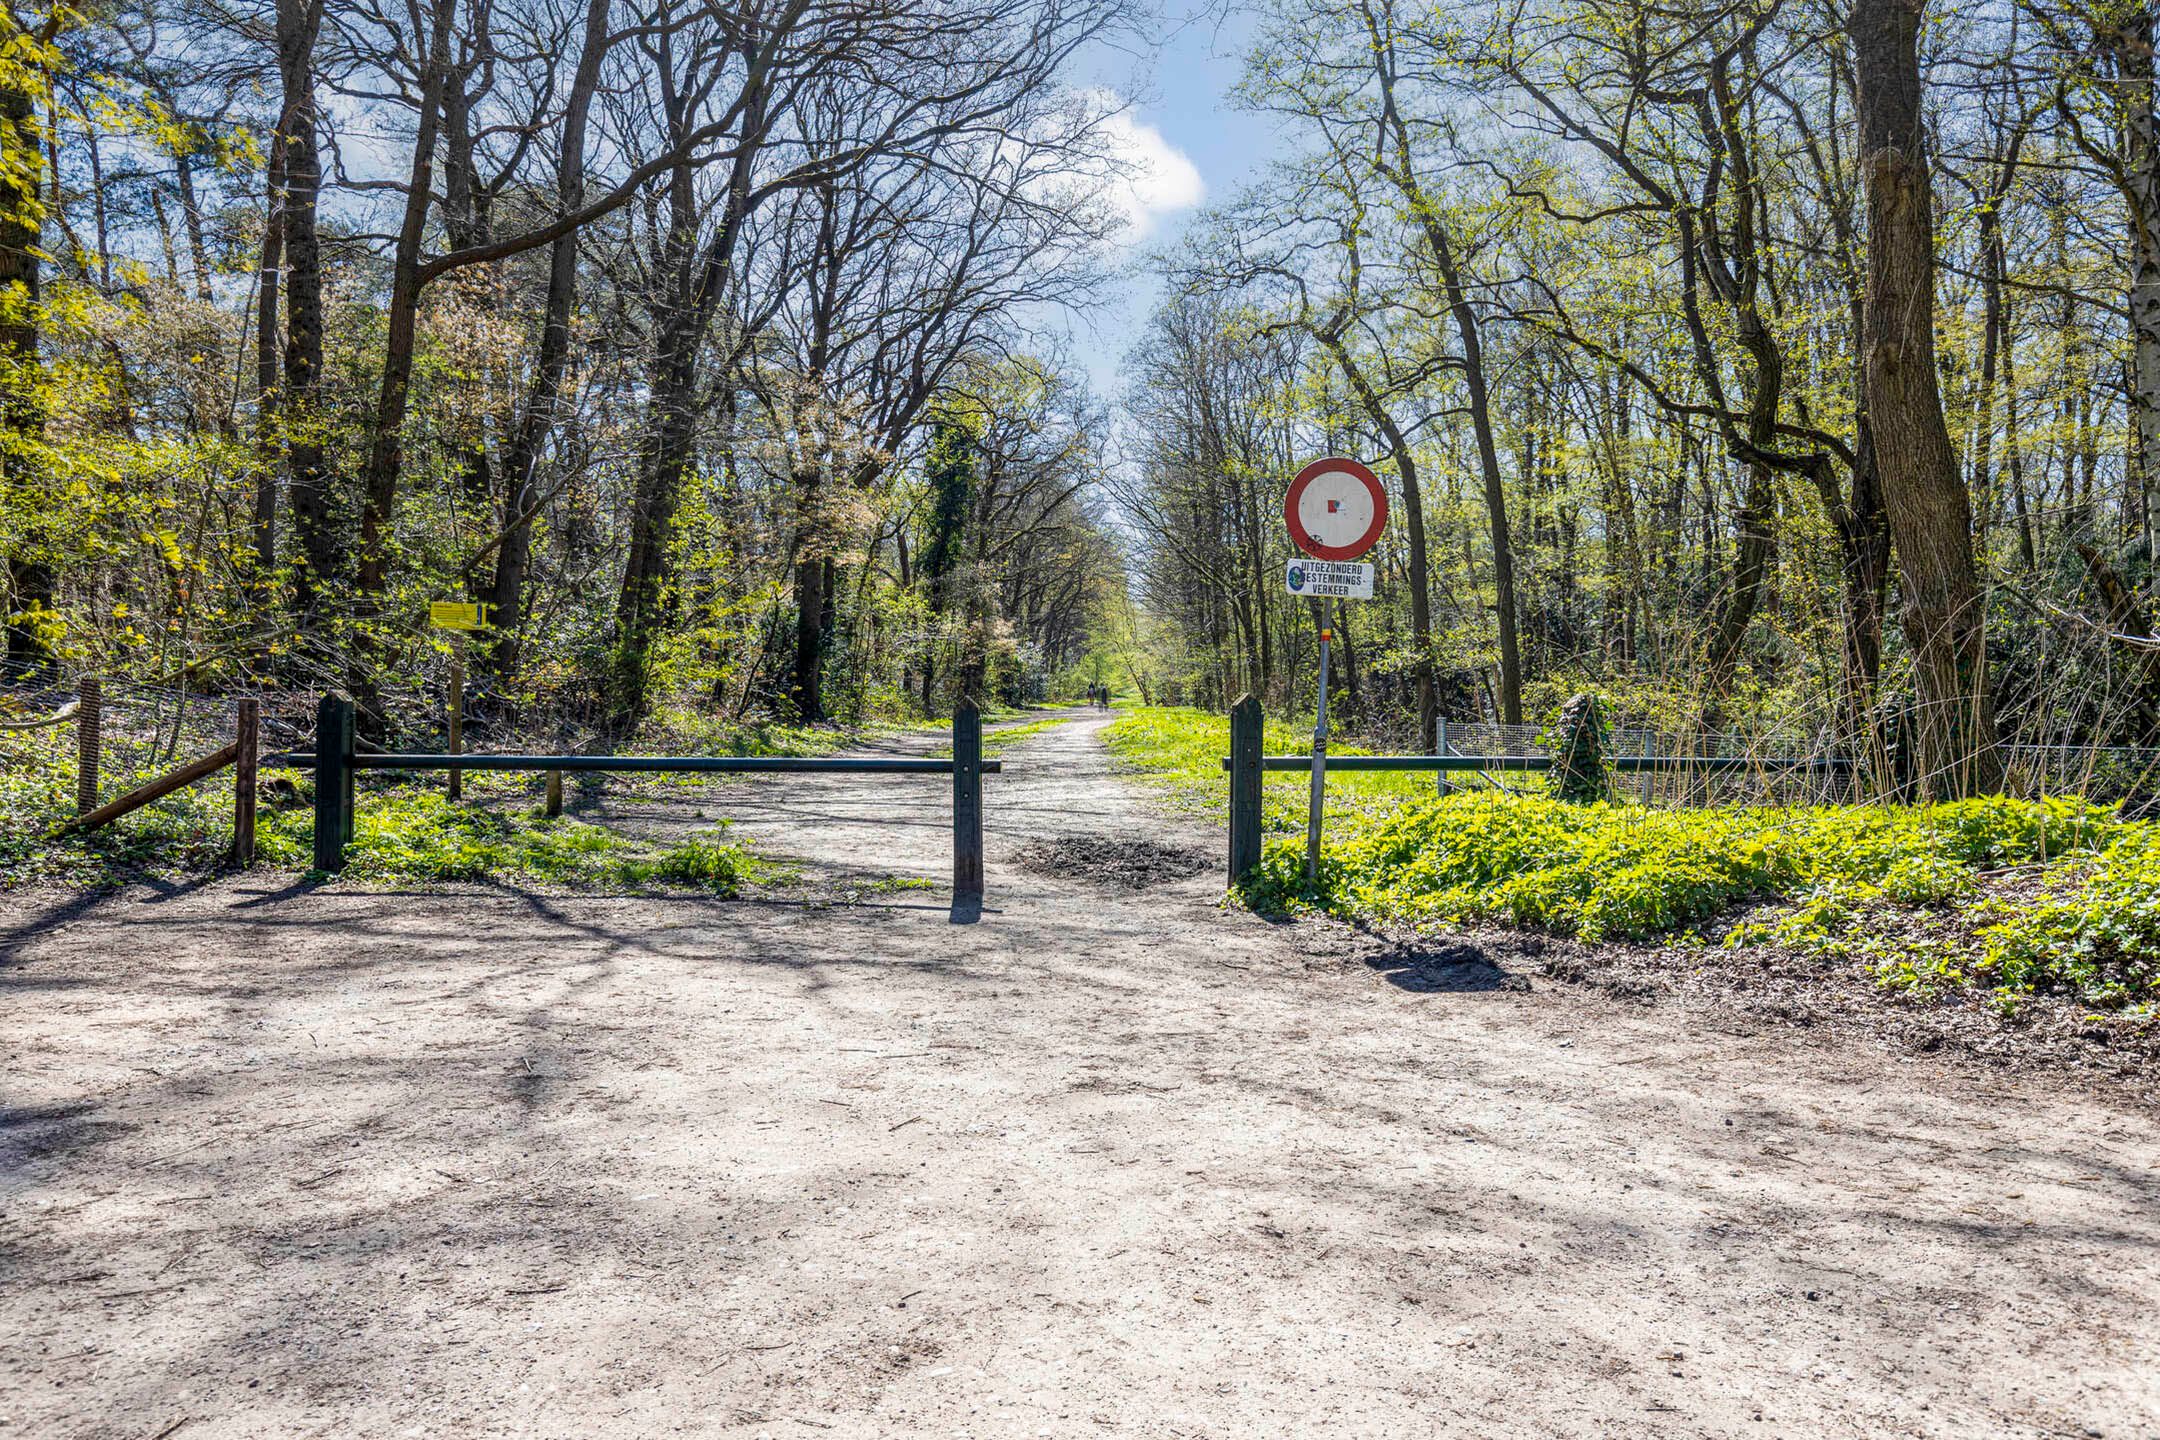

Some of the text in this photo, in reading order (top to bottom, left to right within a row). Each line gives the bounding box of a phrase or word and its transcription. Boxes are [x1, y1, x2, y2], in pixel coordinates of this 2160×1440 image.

[1302, 562, 1362, 574] UITGEZONDERD
[1304, 573, 1366, 585] ESTEMMINGS-
[1313, 584, 1349, 595] VERKEER
